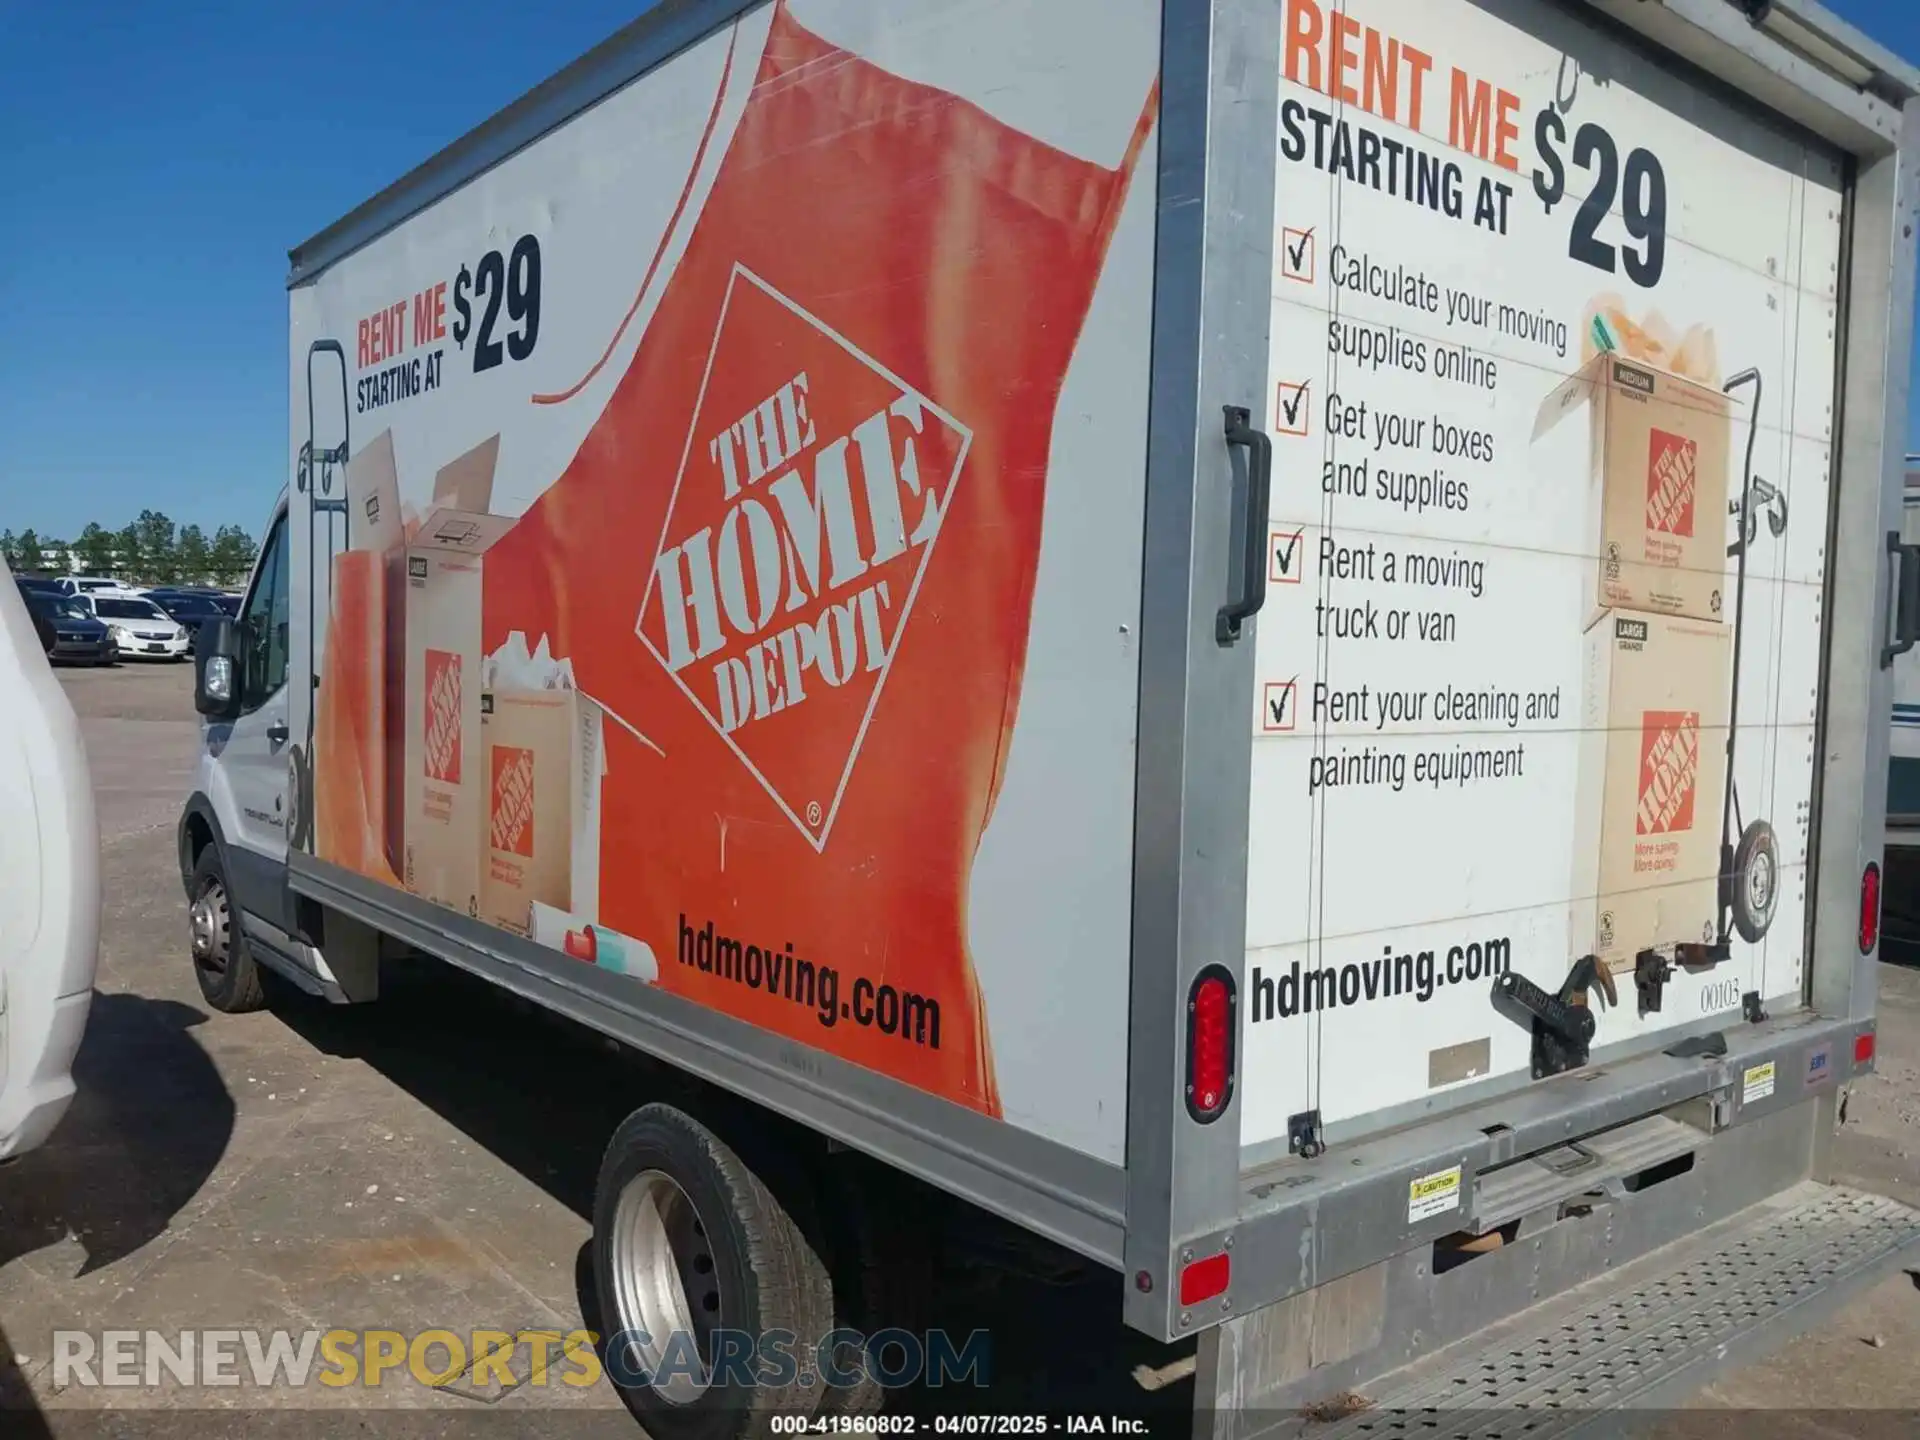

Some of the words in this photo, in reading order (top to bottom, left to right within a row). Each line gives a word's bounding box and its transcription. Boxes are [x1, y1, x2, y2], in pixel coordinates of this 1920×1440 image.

[1284, 0, 1432, 133] RENT
[1448, 66, 1521, 173] ME
[1280, 99, 1463, 220] STARTING
[1474, 176, 1513, 236] AT
[1532, 100, 1668, 289] $29
[358, 299, 407, 369] RENT
[413, 281, 447, 347] ME
[453, 233, 542, 373] $29
[1330, 244, 1438, 313] Calculate
[1446, 287, 1493, 327] your
[1499, 303, 1567, 357] moving
[357, 361, 421, 414] STARTING
[425, 350, 443, 392] AT
[1328, 320, 1427, 374] supplies
[1434, 345, 1497, 390] online
[709, 370, 817, 502] THE
[1325, 393, 1367, 440] Get
[1374, 413, 1426, 452] your
[1433, 415, 1494, 462] boxes
[1322, 457, 1368, 496] and
[1376, 467, 1469, 514] supplies
[654, 392, 940, 672] HOME
[1319, 536, 1376, 582] Rent
[1383, 552, 1396, 582] a
[1405, 550, 1485, 598] moving
[713, 580, 890, 736] DEPOT
[1315, 598, 1378, 639] truck
[1387, 609, 1411, 640] or
[1418, 611, 1456, 642] van
[1617, 620, 1645, 638] LARGE
[1312, 682, 1369, 723] Rent
[1377, 690, 1428, 730] your
[1434, 684, 1519, 728] cleaning
[1526, 686, 1560, 721] and
[1309, 747, 1406, 797] painting
[1414, 744, 1525, 789] equipment
[1637, 711, 1698, 834] HOME
[678, 913, 940, 1050] hdmoving.com
[1251, 936, 1511, 1024] hdmoving.com
[1700, 977, 1741, 1013] 00103
